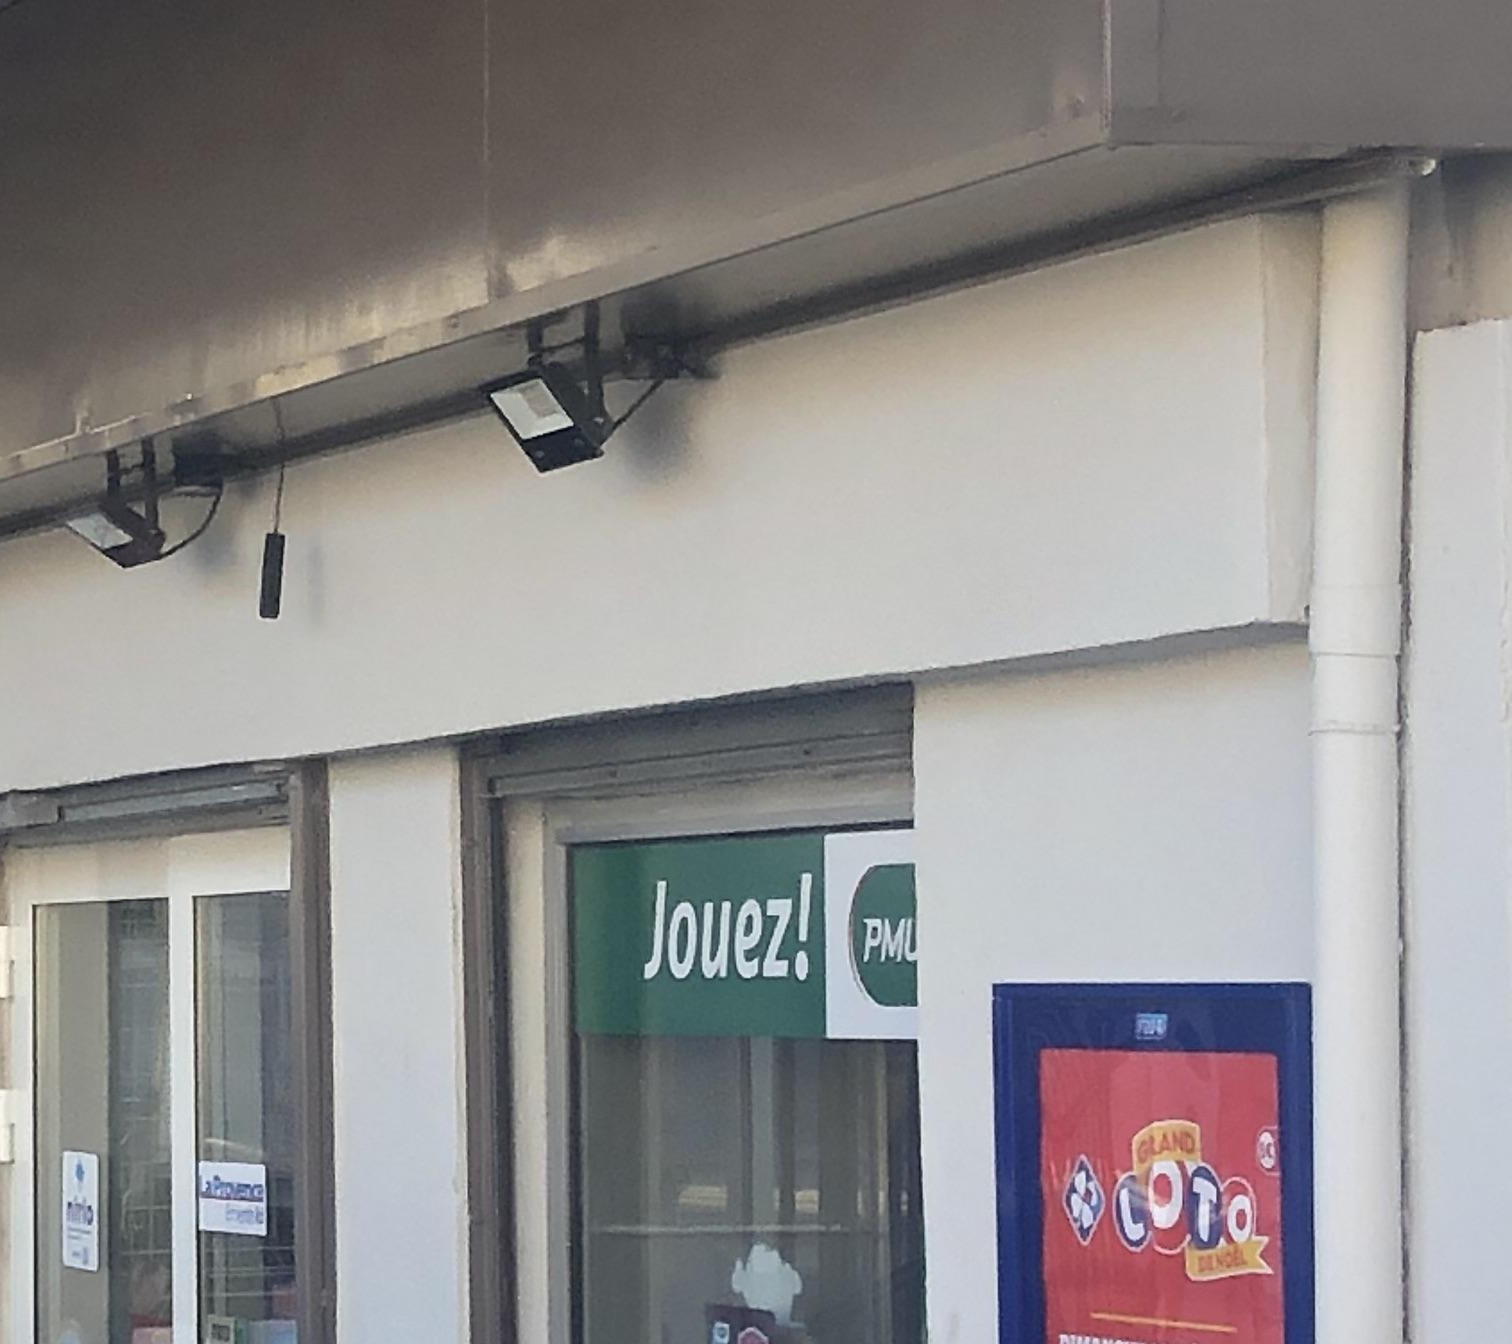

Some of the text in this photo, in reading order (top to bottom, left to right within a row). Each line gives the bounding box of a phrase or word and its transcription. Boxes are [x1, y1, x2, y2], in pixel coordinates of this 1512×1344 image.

[643, 872, 917, 981] Jouez! PMU
[1119, 1159, 1253, 1243] LOTO
